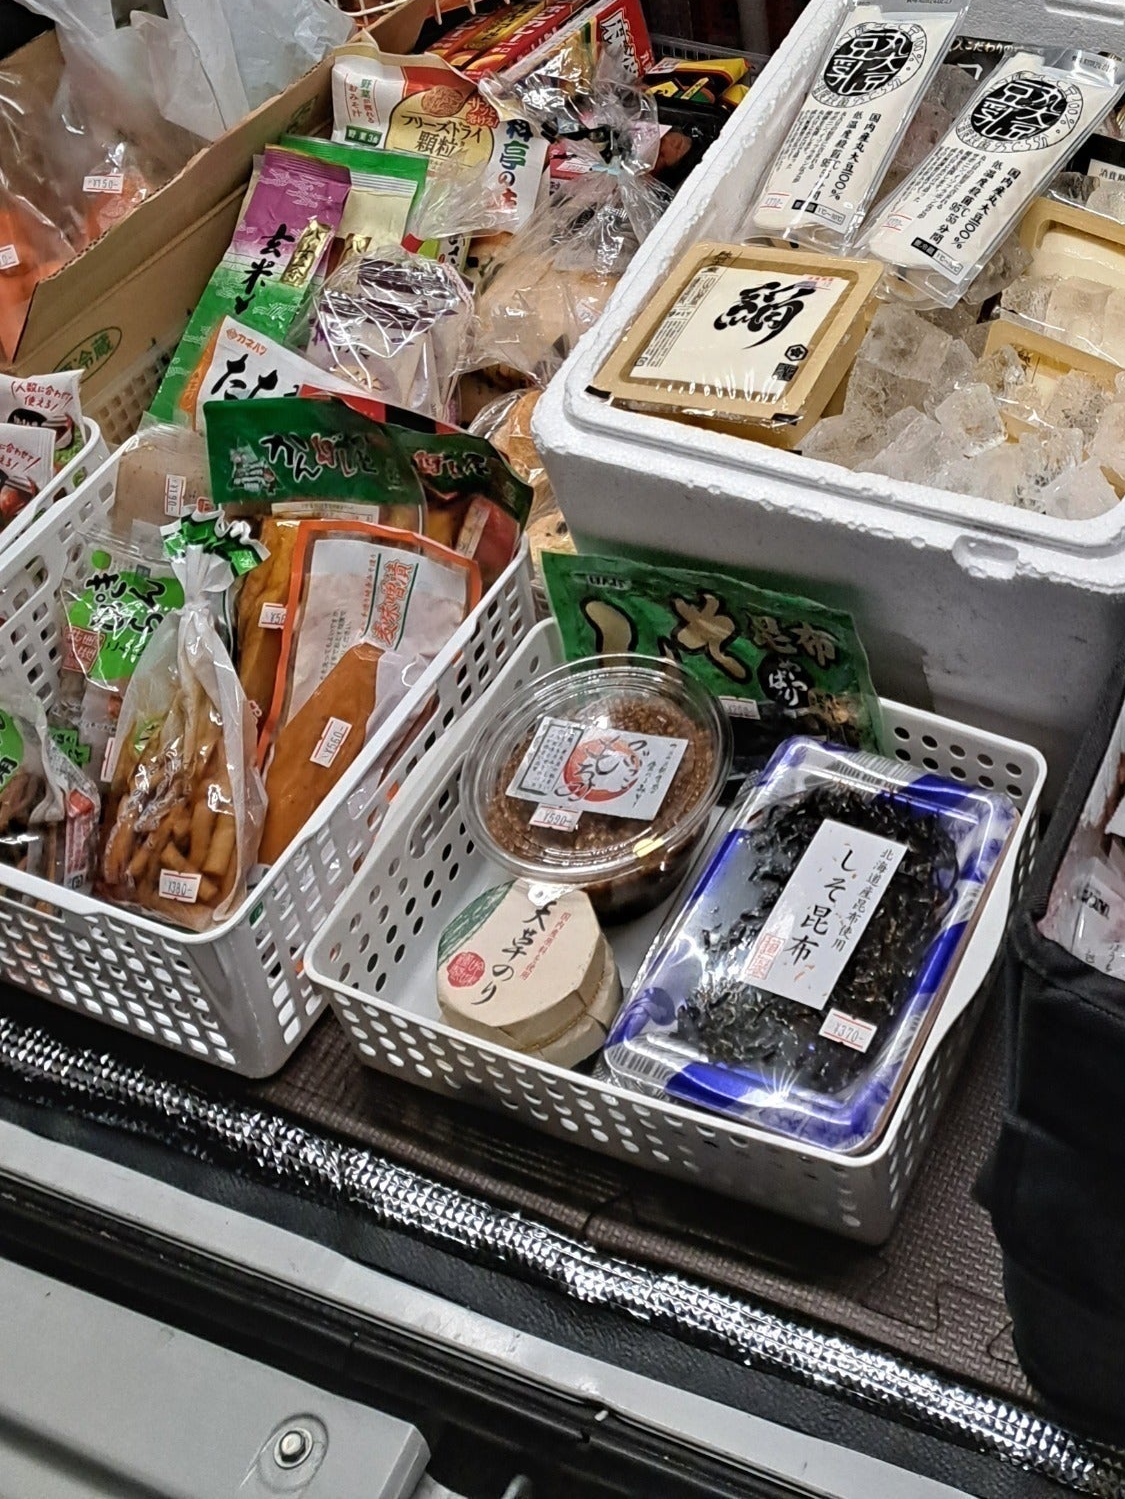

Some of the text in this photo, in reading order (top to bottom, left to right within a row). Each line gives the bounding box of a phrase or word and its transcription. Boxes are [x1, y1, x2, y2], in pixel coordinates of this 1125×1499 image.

[402, 115, 483, 143] フリーズドライ
[415, 131, 458, 158] 顆粒
[785, 850, 857, 966] しそ昆布
[831, 848, 894, 952] 北海道産昆布使用
